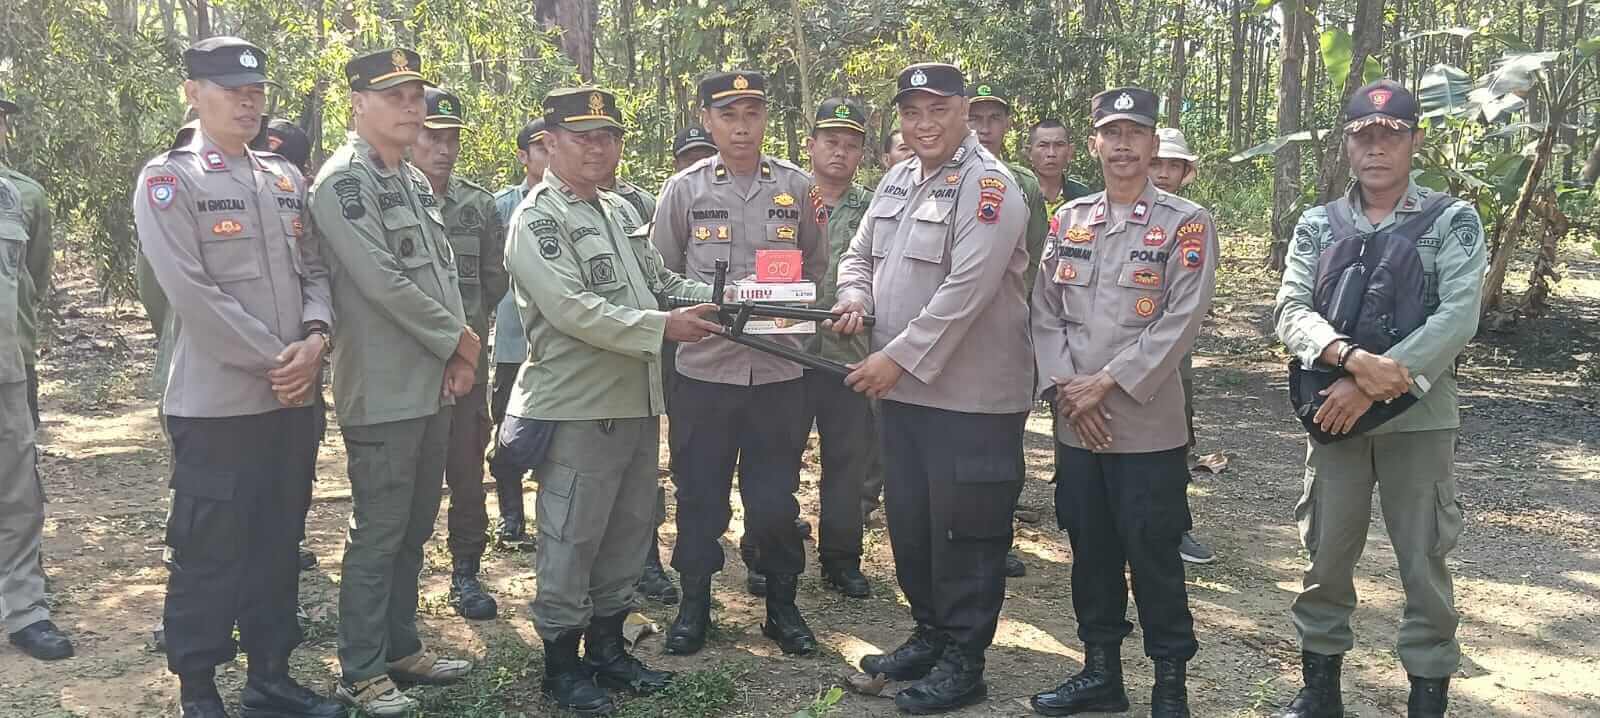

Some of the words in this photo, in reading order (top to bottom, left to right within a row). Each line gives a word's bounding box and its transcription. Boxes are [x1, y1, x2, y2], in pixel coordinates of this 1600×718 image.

[208, 199, 247, 211] GHOZALI
[768, 208, 799, 220] POLRI
[741, 288, 773, 299] LUBY
